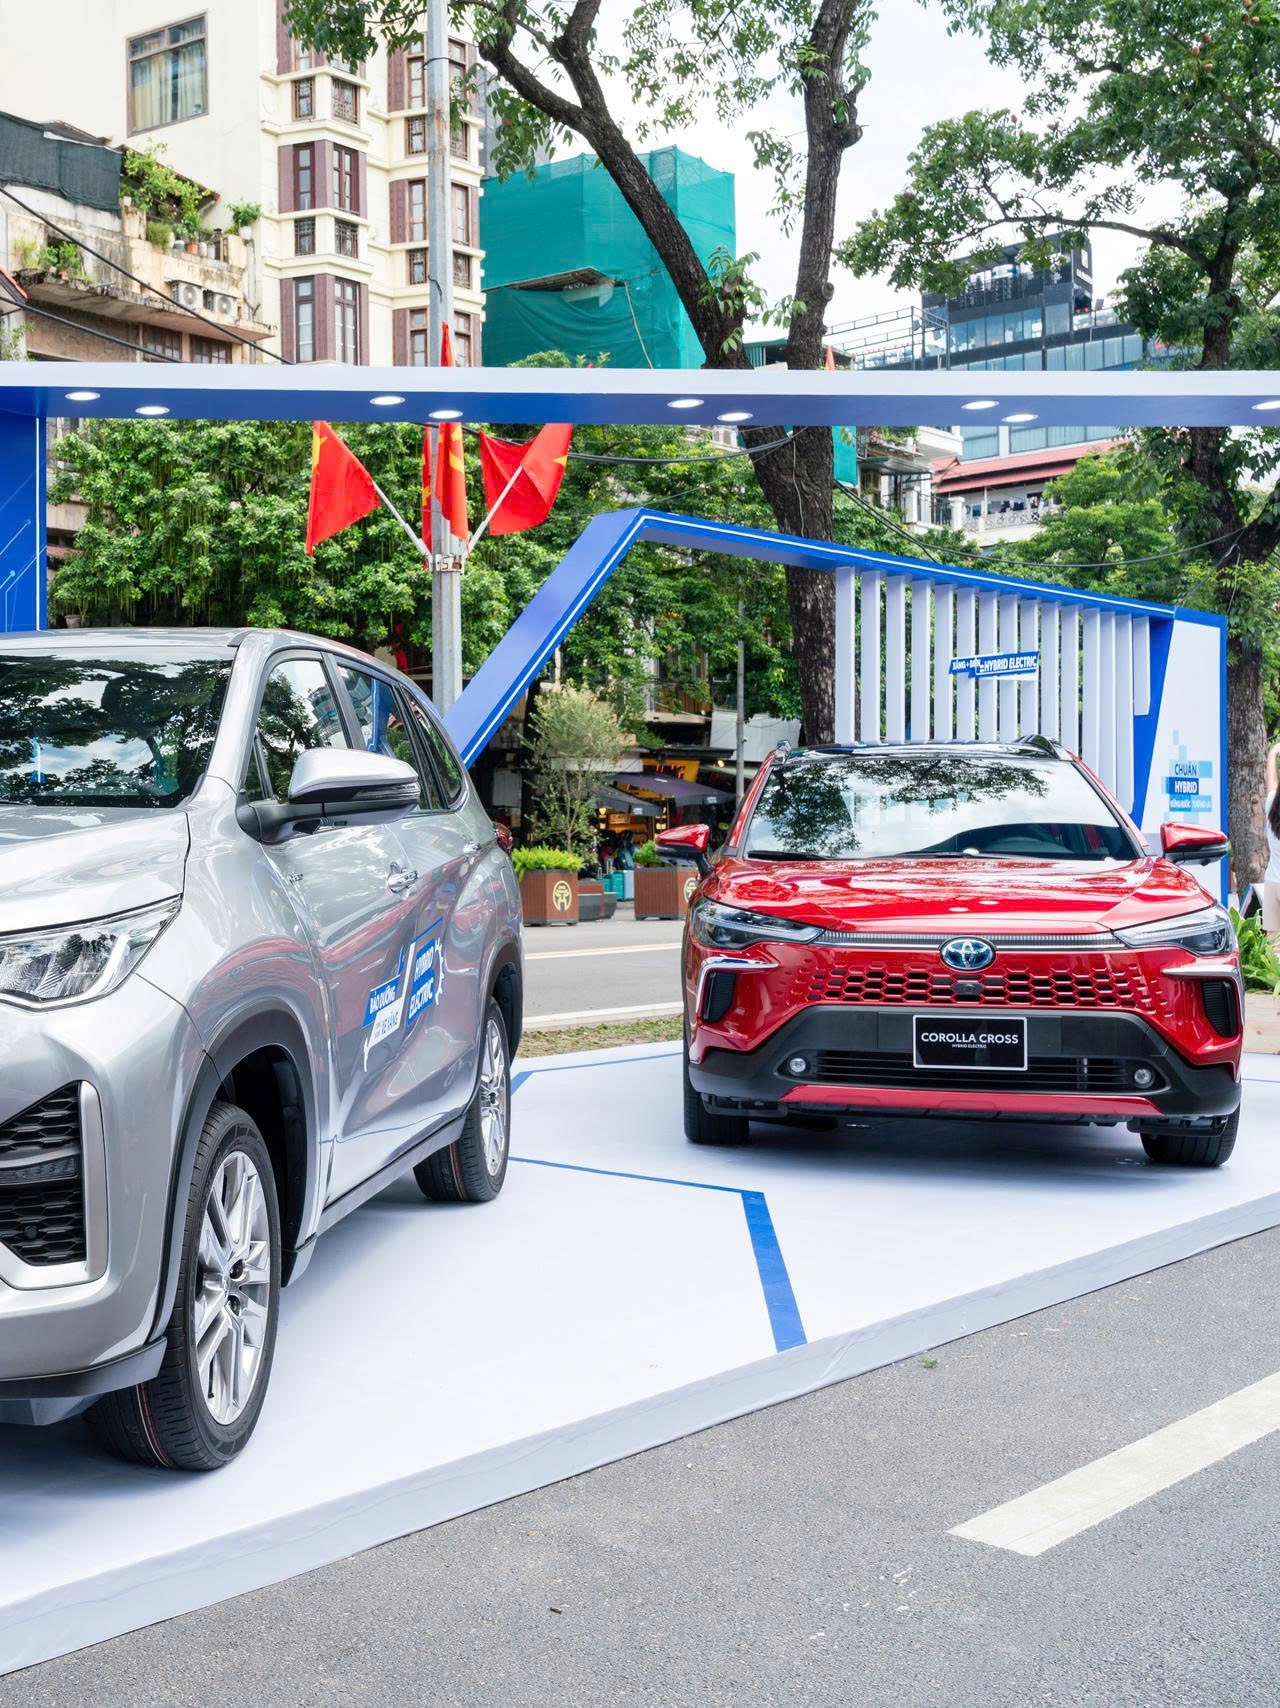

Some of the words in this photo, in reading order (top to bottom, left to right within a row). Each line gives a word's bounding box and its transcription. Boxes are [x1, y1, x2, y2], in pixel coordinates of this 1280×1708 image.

[1009, 656, 1037, 669] ELECTRIC
[1174, 780, 1198, 793] HYBRID
[921, 1032, 976, 1043] COROLLA
[979, 1034, 1018, 1044] CROSS
